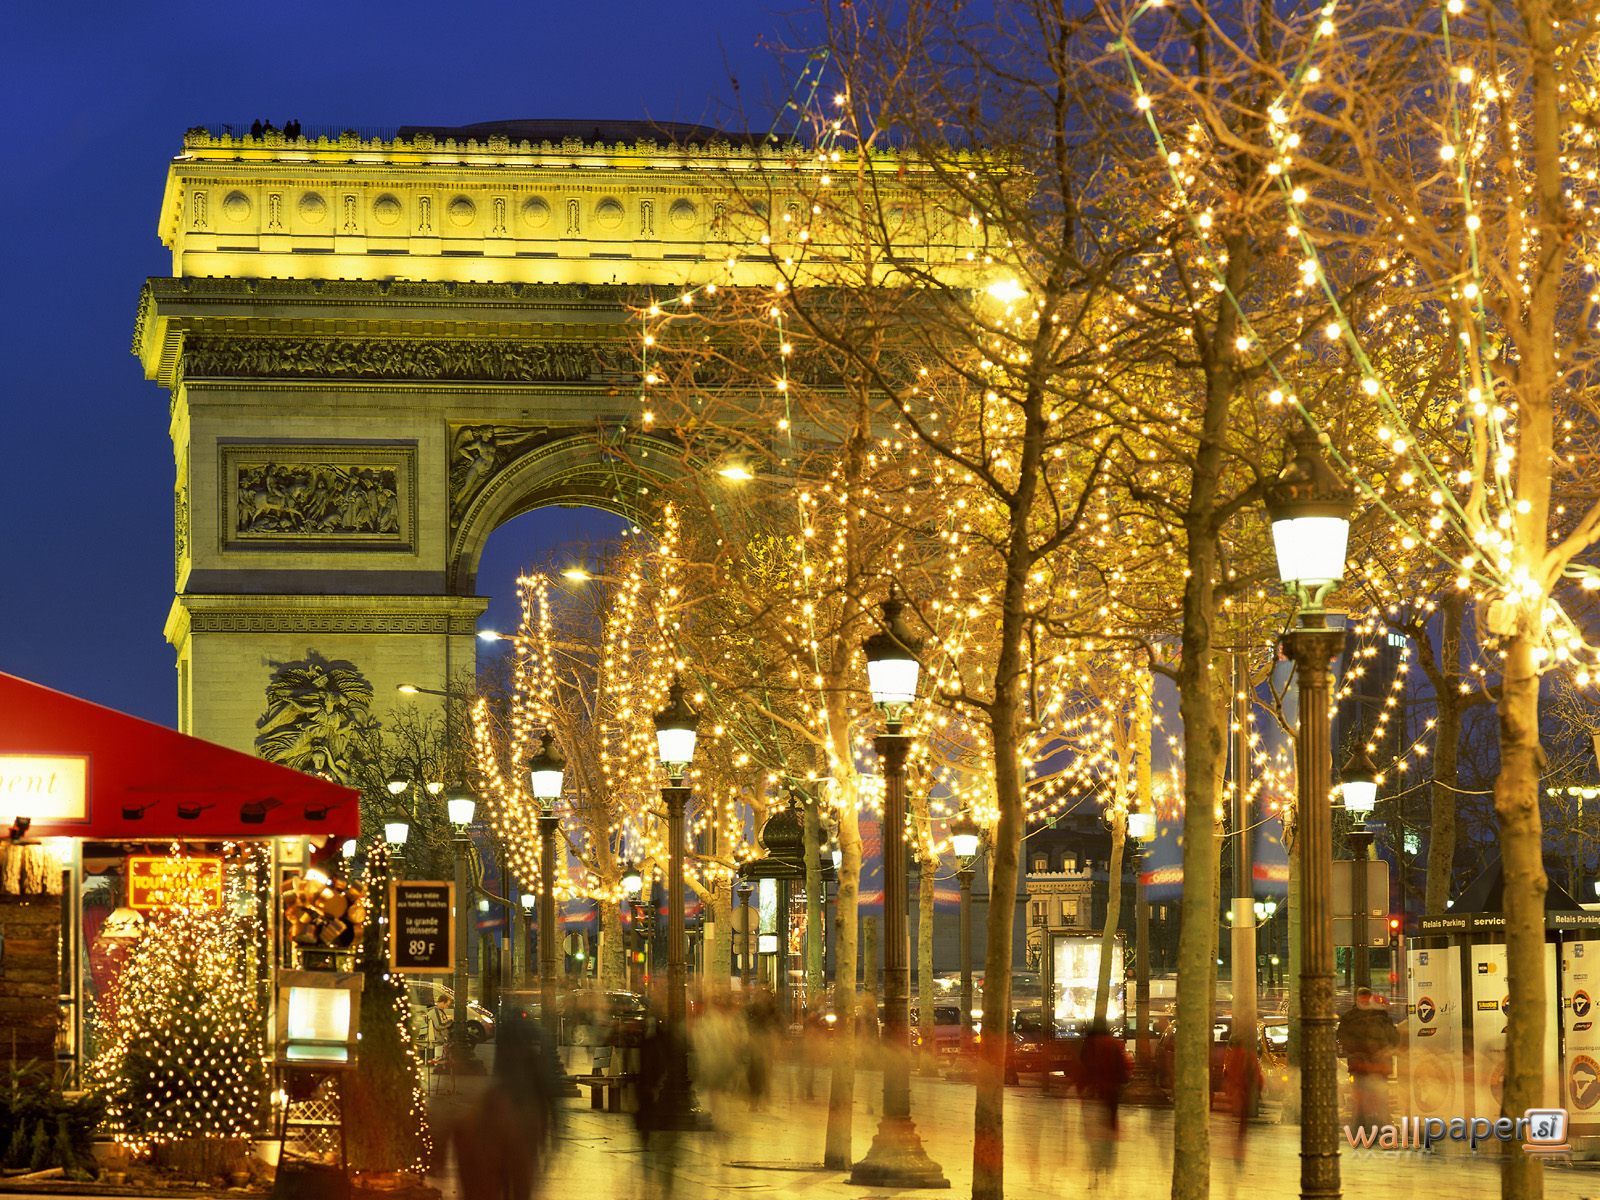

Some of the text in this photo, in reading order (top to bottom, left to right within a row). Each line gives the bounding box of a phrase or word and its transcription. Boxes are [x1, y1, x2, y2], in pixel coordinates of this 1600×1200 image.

[414, 917, 438, 927] grande
[1422, 919, 1466, 929] Relais Parking
[1555, 915, 1577, 923] Relais
[408, 940, 435, 955] 89 F
